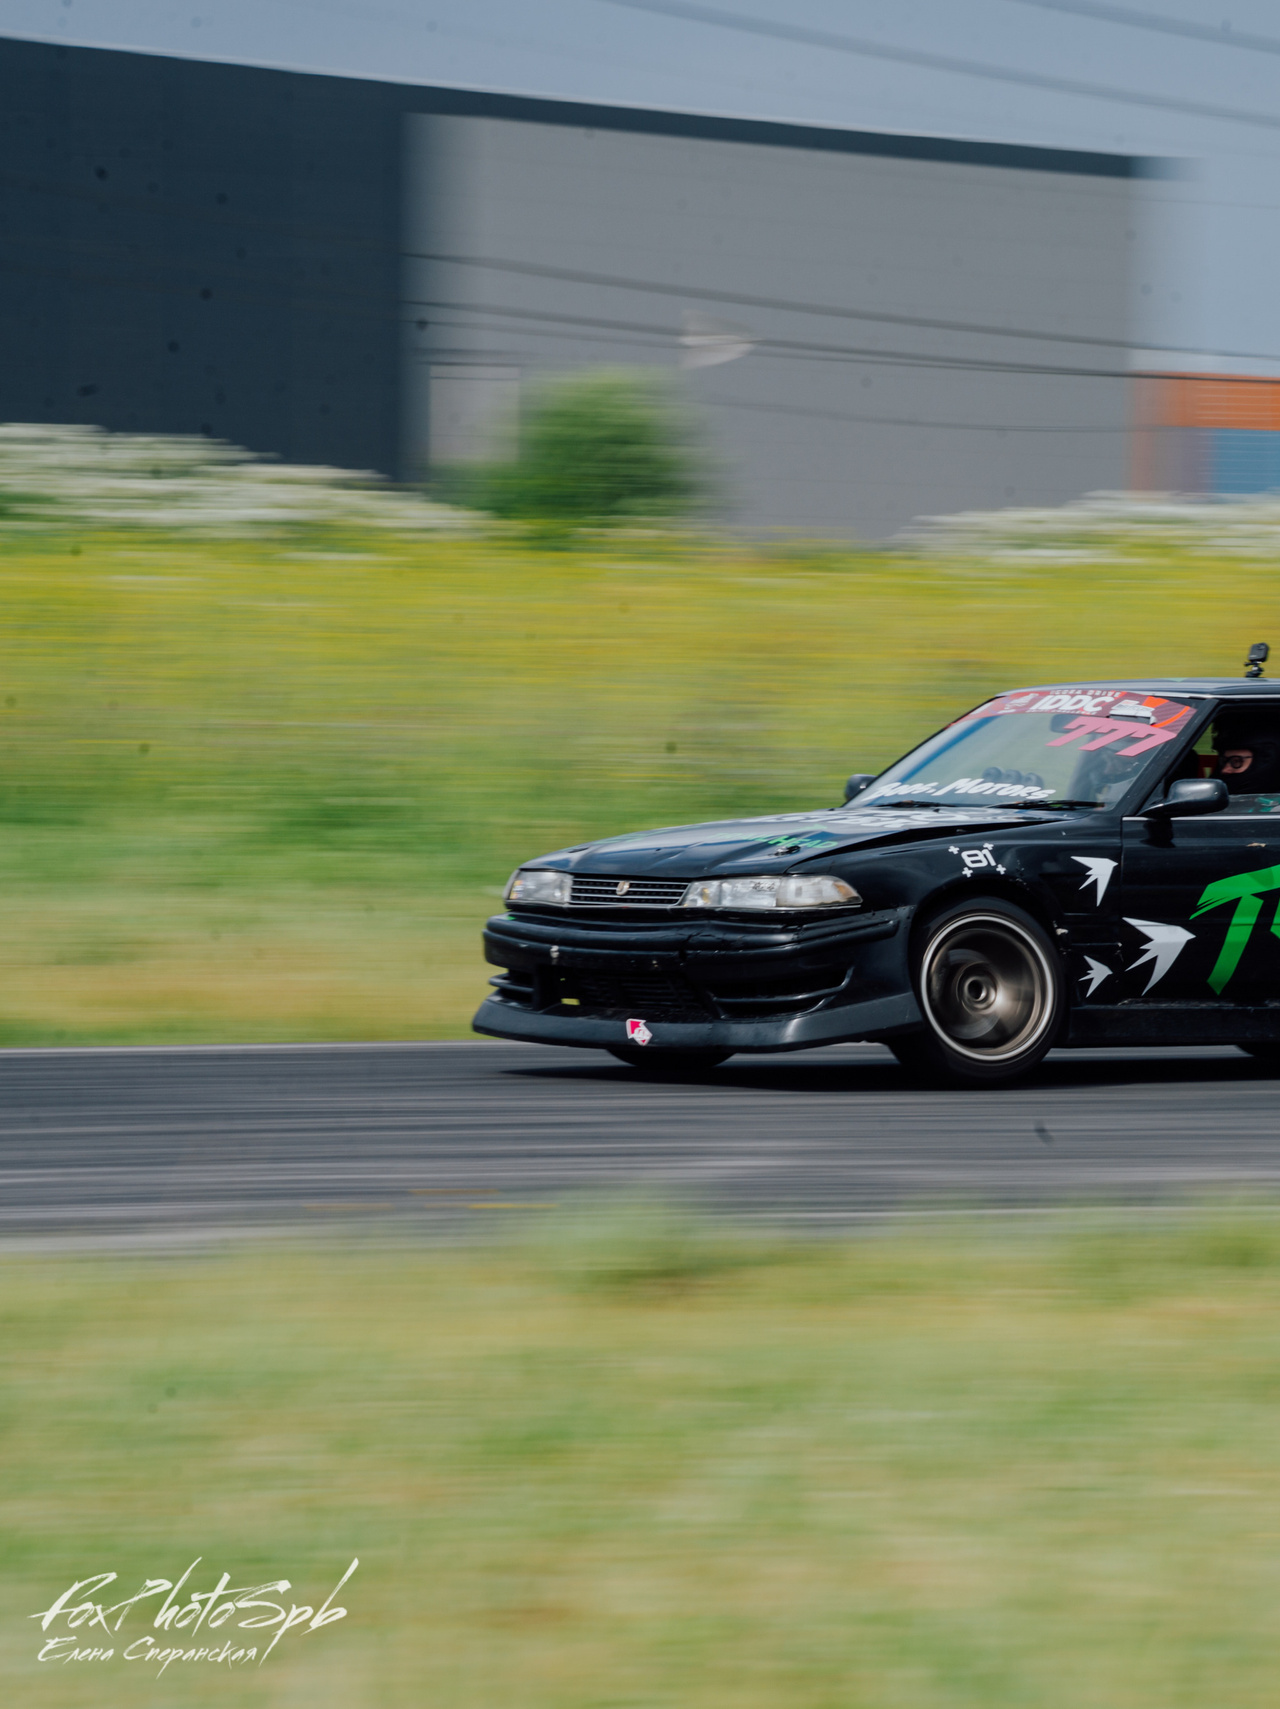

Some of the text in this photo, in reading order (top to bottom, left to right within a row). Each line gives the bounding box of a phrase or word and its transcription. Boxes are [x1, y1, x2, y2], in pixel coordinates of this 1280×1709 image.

[1030, 694, 1115, 714] IDDC
[1045, 716, 1178, 757] 777
[961, 848, 997, 868] 81
